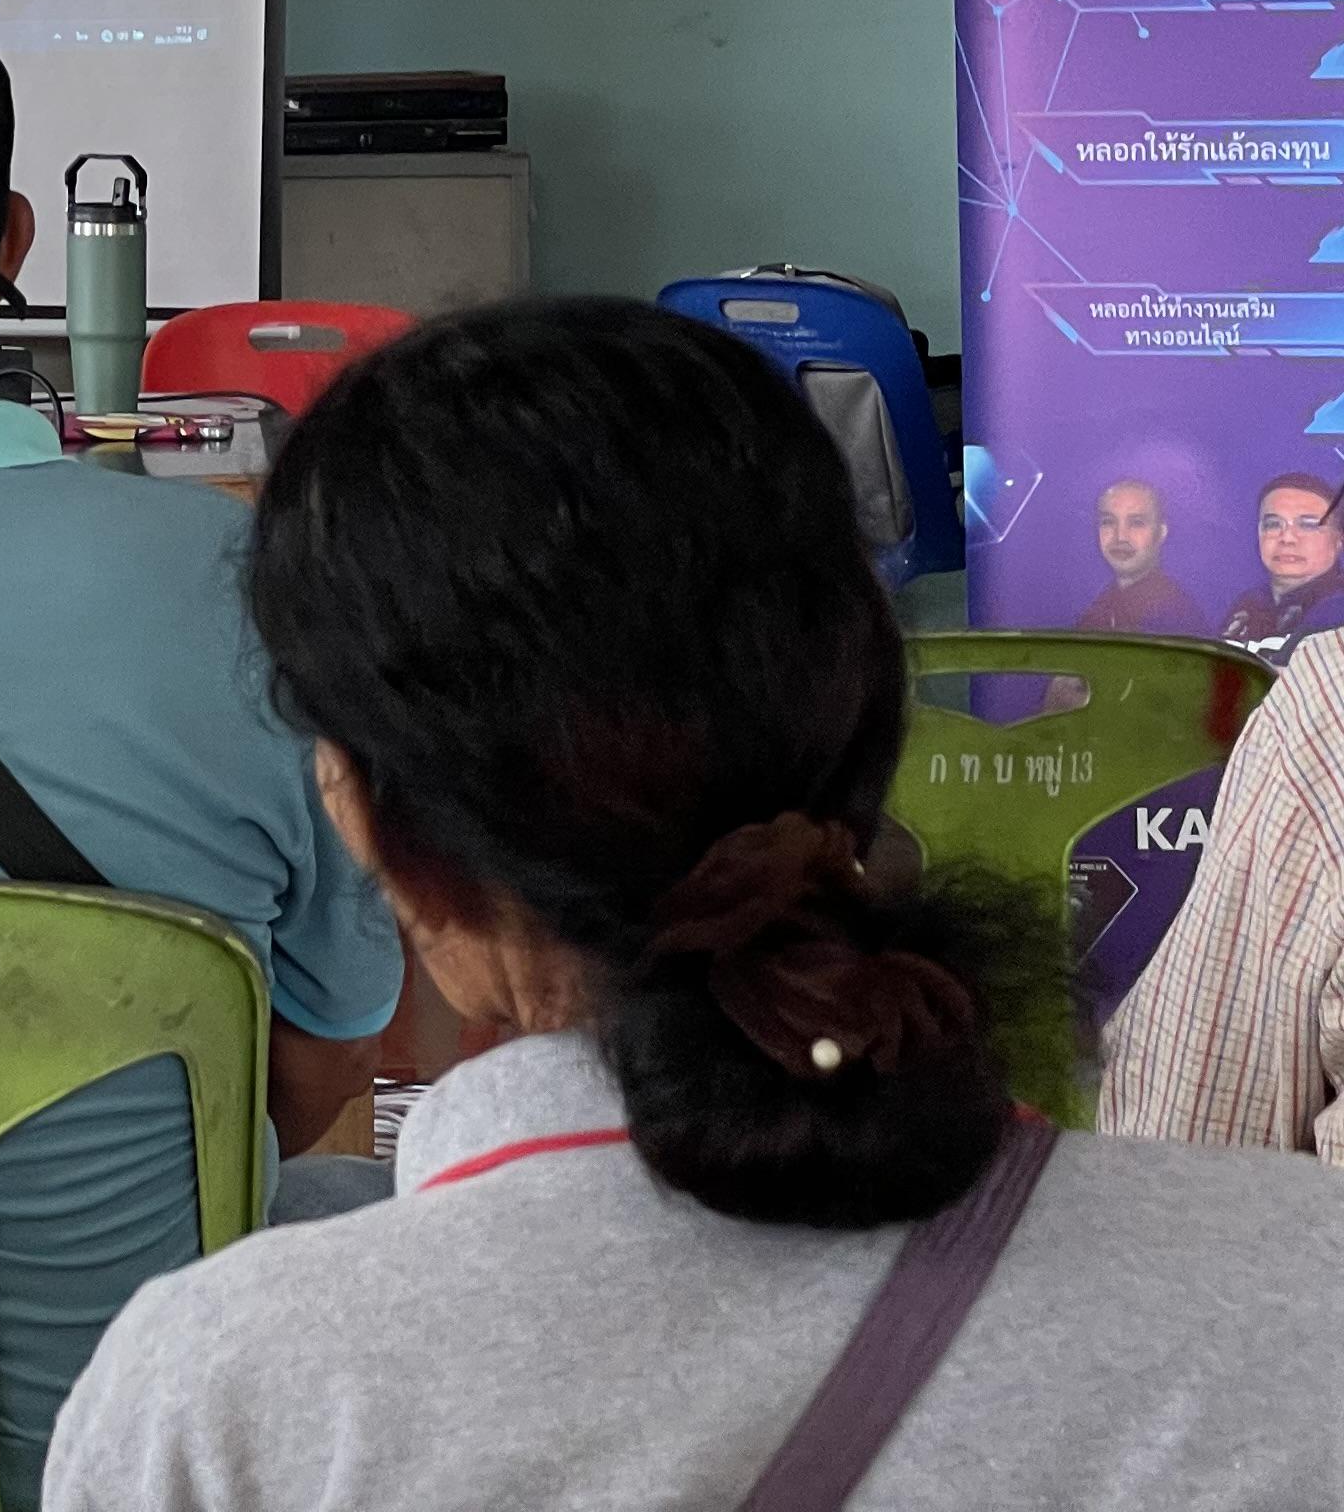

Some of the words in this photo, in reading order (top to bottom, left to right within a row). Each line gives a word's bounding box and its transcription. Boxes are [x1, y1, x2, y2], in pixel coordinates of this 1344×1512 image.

[1076, 131, 1330, 169] หลอกให้รักแล้วลงทุน
[1088, 294, 1275, 320] หลอกให้ทำงานเสริม
[1124, 322, 1241, 347] ทางออนไลน์
